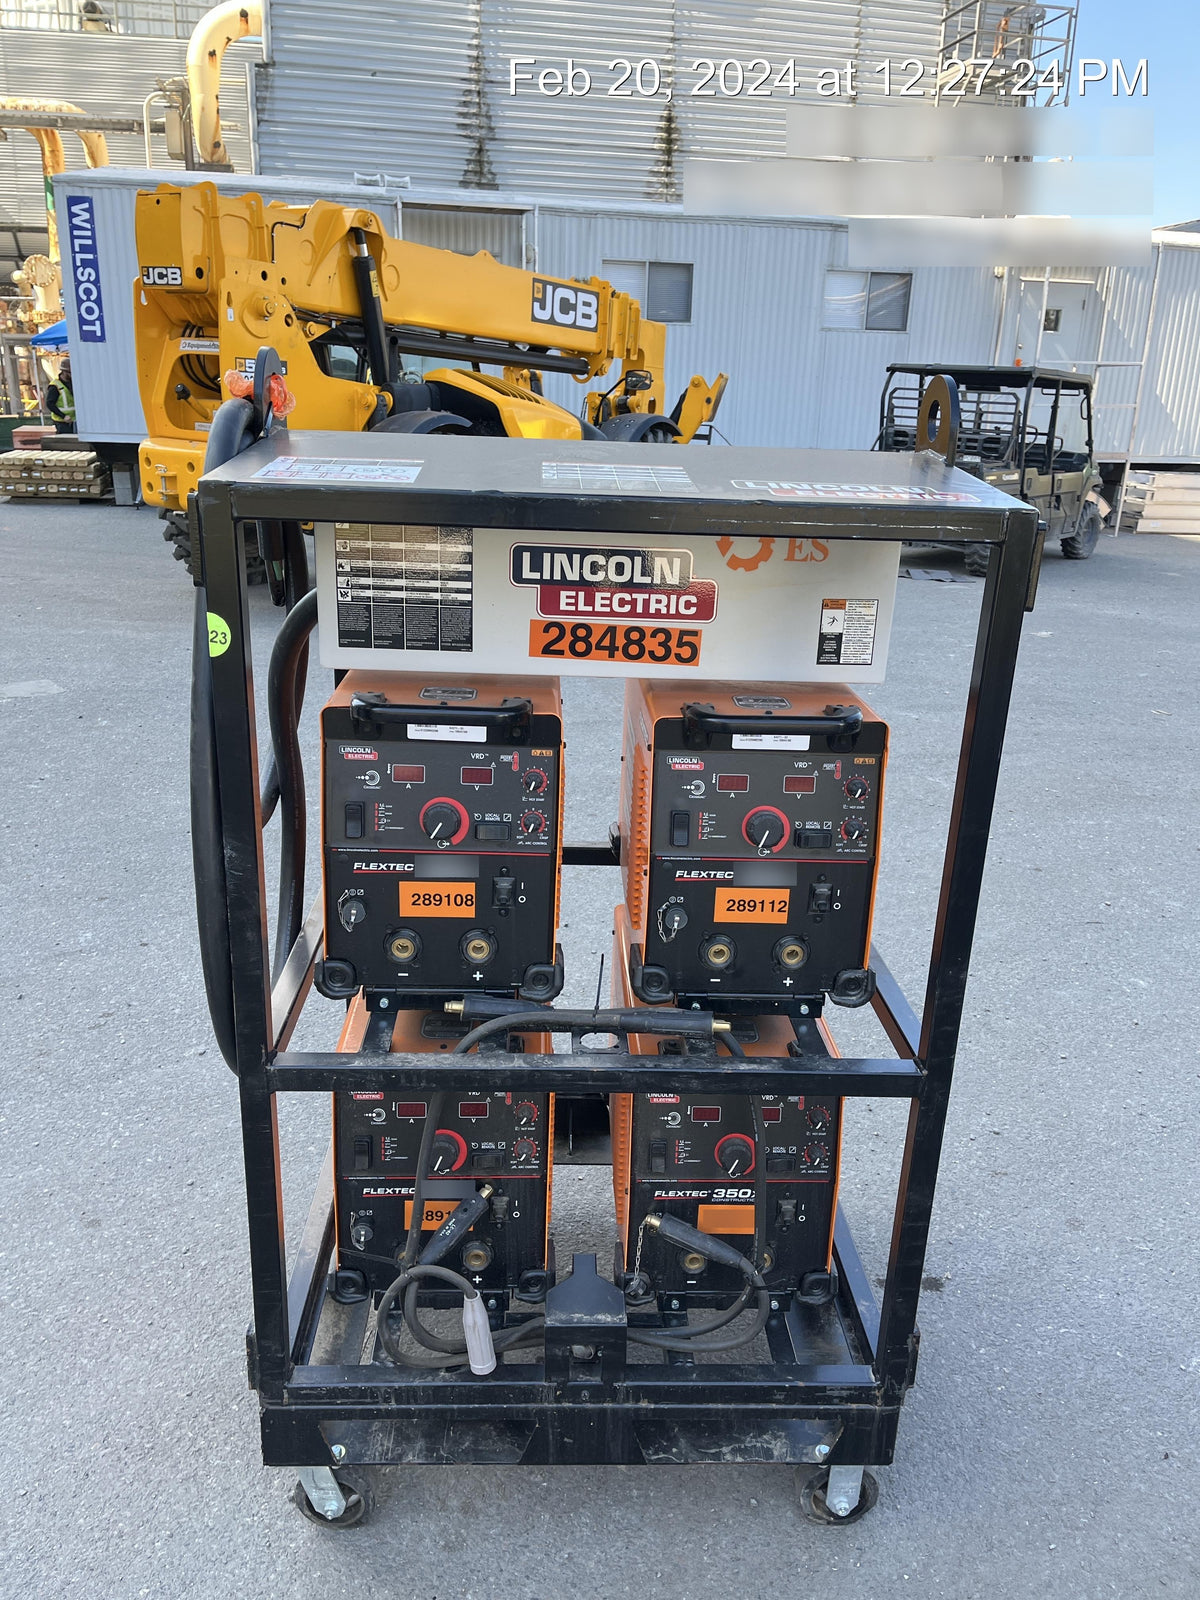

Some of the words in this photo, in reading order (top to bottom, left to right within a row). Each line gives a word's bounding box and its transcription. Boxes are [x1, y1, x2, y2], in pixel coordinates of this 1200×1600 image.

[71, 201, 102, 337] WILLSCOT
[143, 267, 182, 285] JCB
[533, 285, 598, 328] JCB
[521, 550, 680, 586] LINCOLN
[558, 591, 698, 616] ELECTRIC
[209, 630, 228, 645] 23
[541, 621, 700, 664] 284835
[341, 746, 371, 754] LINCOLN
[668, 757, 698, 765] LINCOLN
[405, 782, 412, 790] A
[353, 862, 415, 871] FLEXTEC
[675, 870, 734, 879] FLEXTEC
[410, 893, 475, 907] 289108
[726, 899, 788, 913] 289112
[363, 1187, 416, 1195] FLEXTEC
